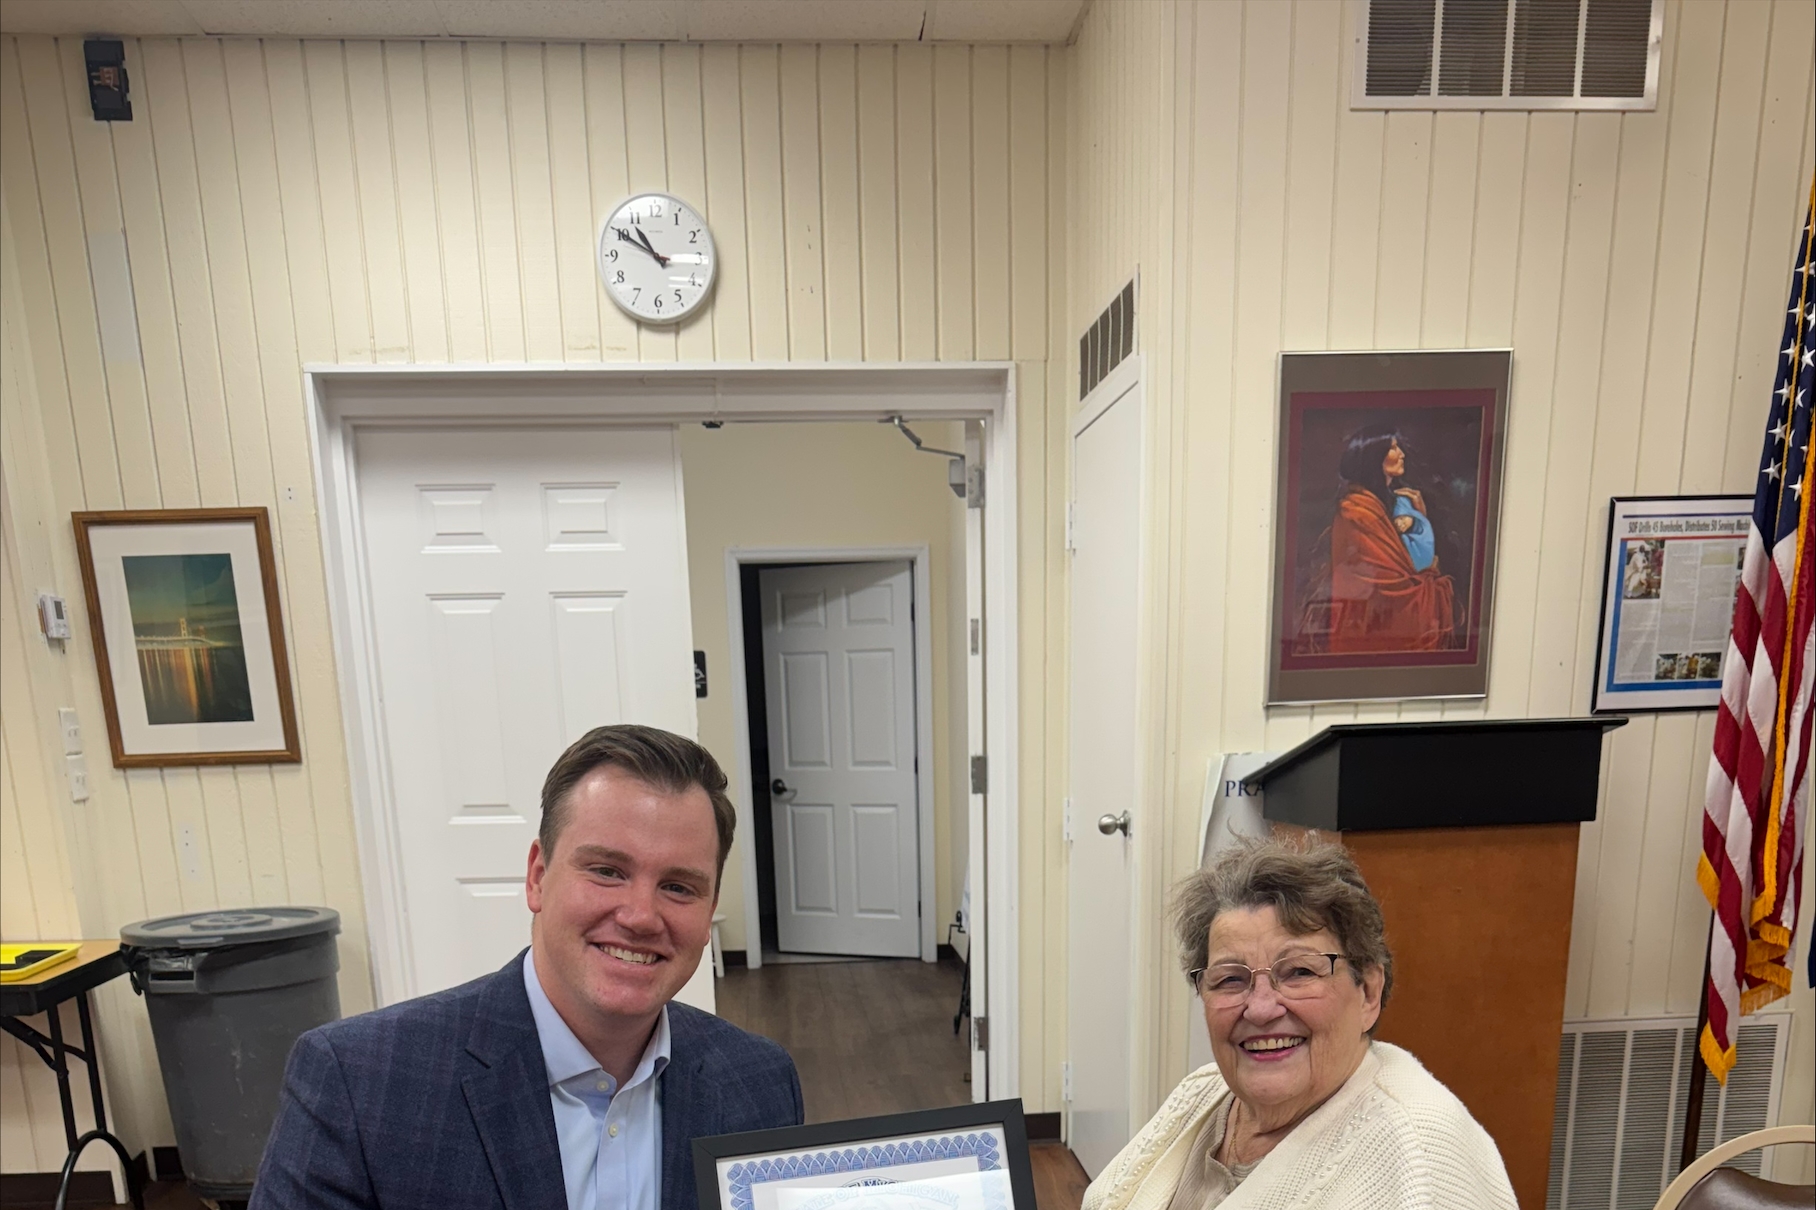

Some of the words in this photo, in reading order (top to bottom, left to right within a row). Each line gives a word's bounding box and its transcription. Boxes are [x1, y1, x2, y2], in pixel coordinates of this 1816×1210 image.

[649, 204, 662, 217] 12
[630, 212, 641, 224] 11
[674, 213, 680, 226] 1
[617, 228, 630, 241] 10
[689, 230, 697, 243] 2
[610, 249, 618, 262] 9
[617, 270, 625, 283] 8
[688, 272, 696, 286] 4
[633, 288, 641, 301] 7
[654, 294, 662, 308] 6
[674, 289, 682, 303] 5
